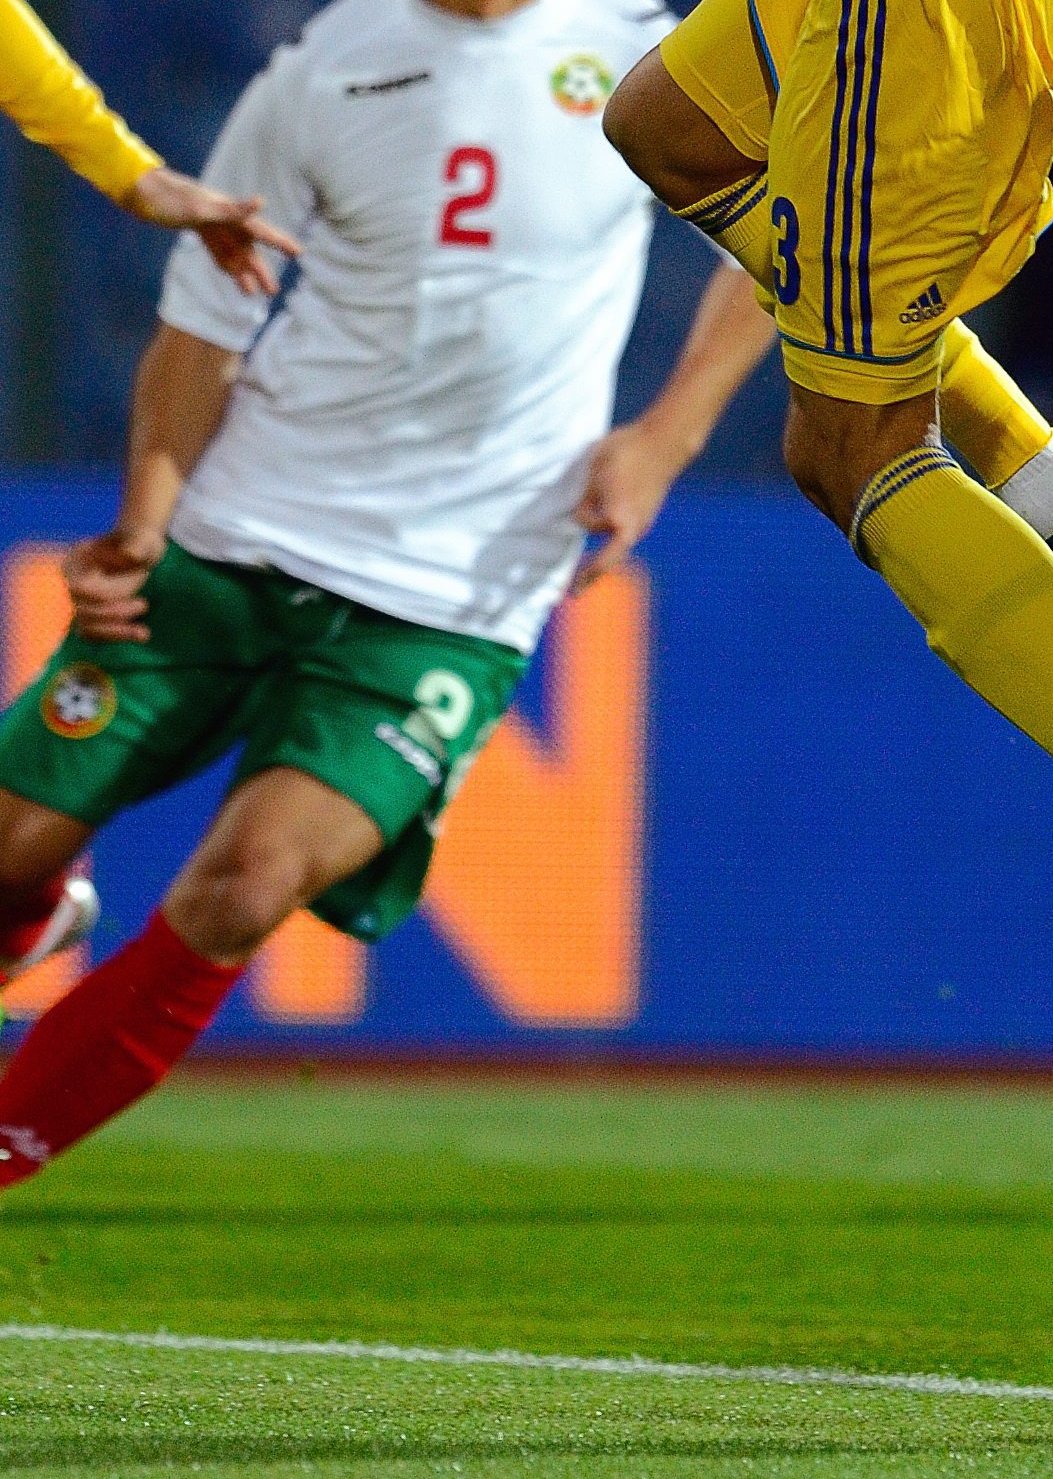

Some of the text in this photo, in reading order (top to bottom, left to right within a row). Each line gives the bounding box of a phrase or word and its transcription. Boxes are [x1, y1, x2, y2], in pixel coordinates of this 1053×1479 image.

[439, 145, 498, 248] 2
[771, 196, 799, 306] 3
[413, 668, 475, 762] 2
